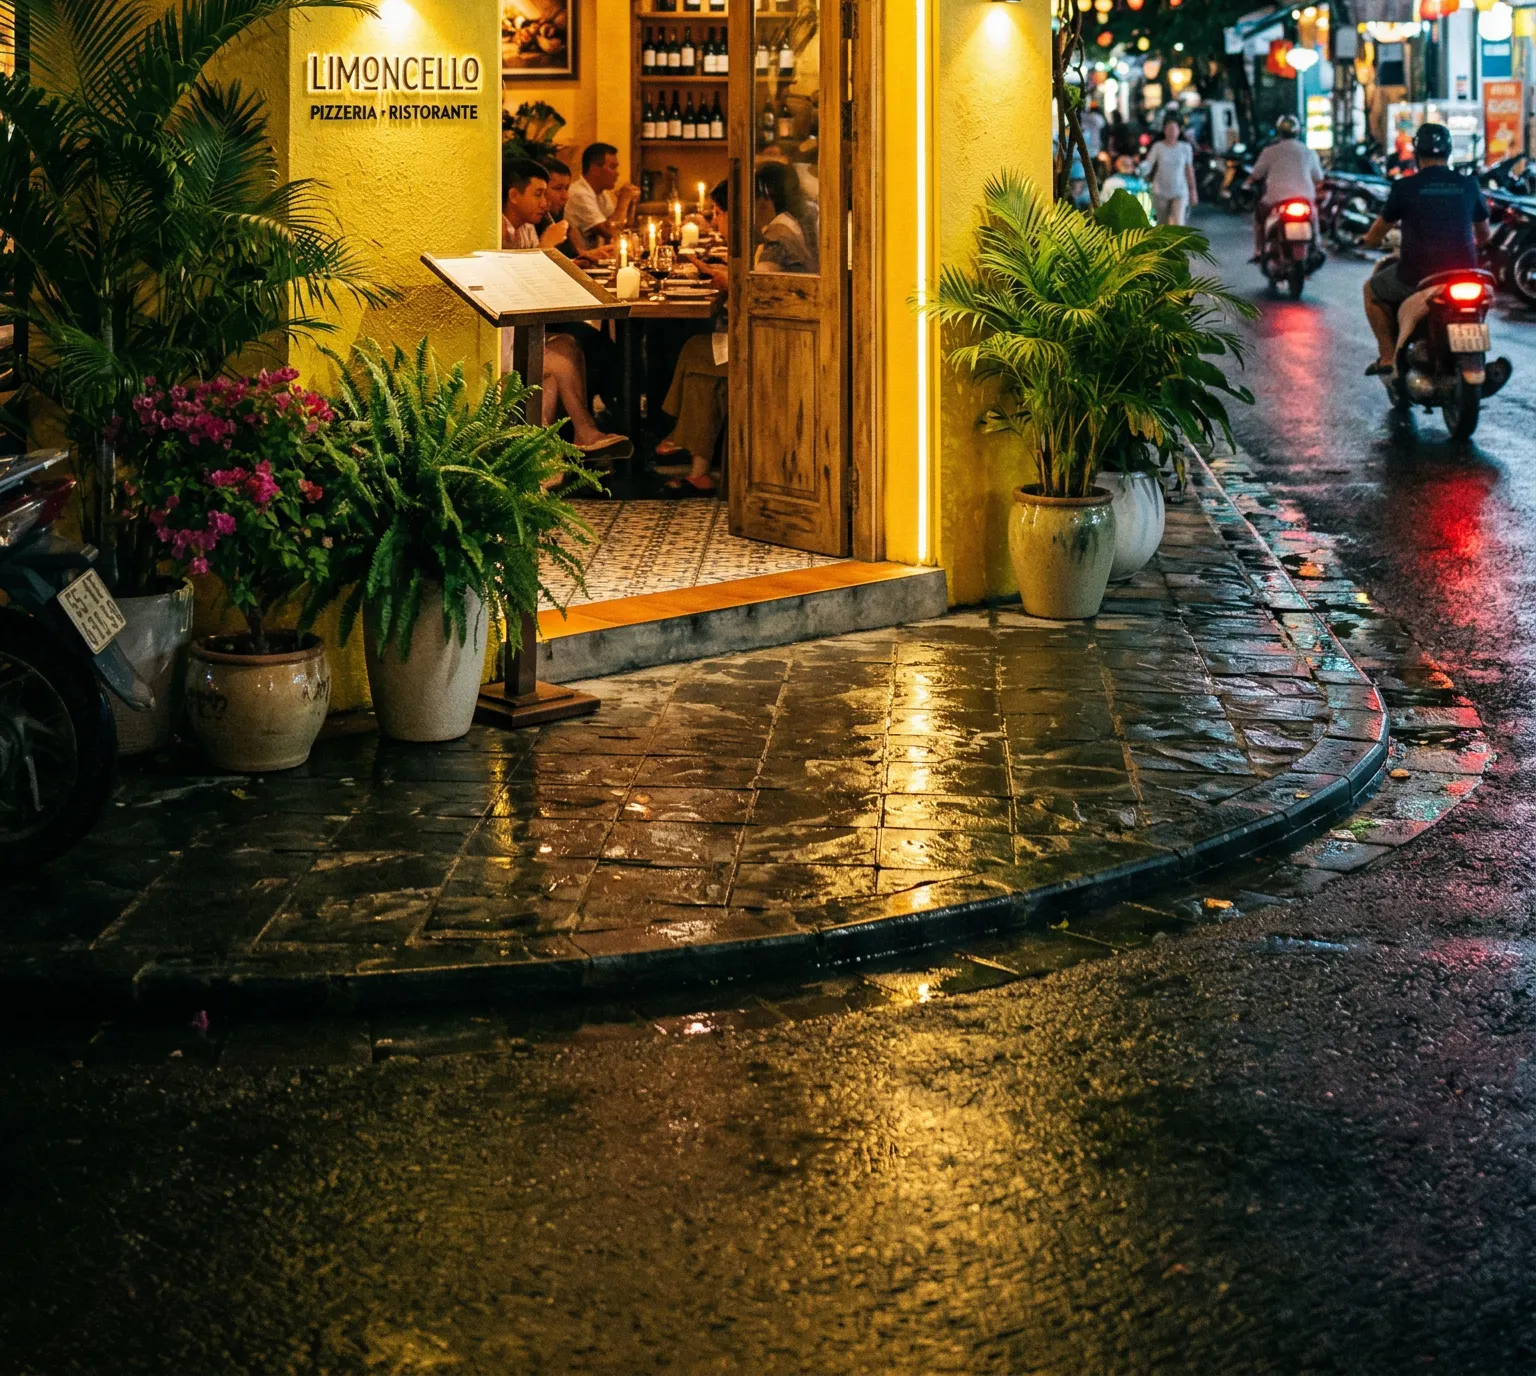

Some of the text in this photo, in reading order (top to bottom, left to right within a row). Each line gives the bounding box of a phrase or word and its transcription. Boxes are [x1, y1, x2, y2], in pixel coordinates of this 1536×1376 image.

[311, 55, 480, 91] LIMONCELLO
[310, 105, 377, 120] PIZZERIA
[389, 104, 478, 120] RISTORANTE
